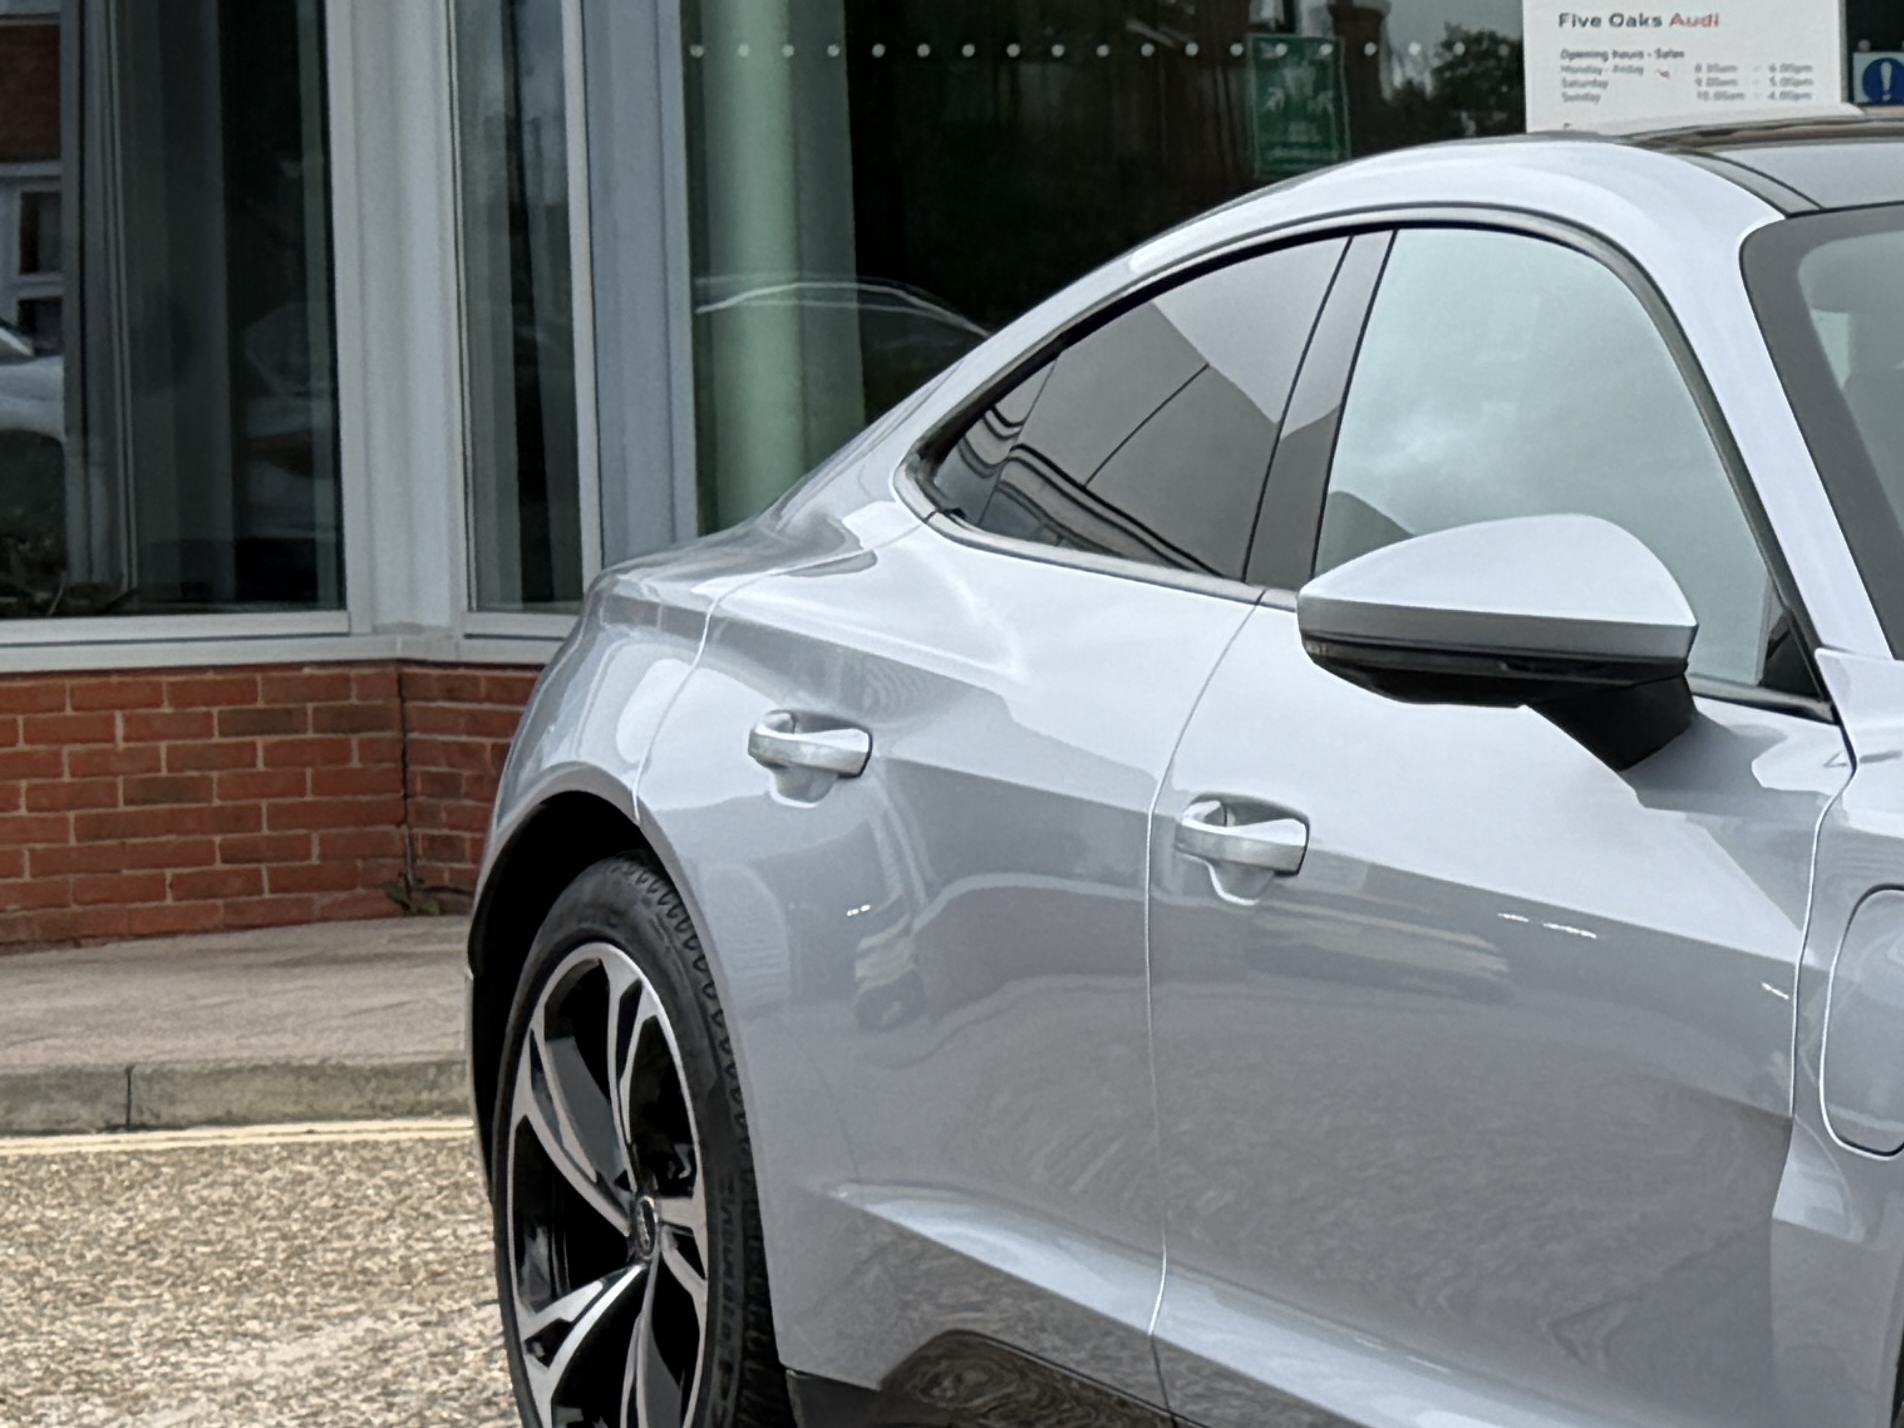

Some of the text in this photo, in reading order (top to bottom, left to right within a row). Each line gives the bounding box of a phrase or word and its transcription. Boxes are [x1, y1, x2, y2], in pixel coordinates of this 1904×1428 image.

[1558, 12, 1720, 28] Five Oaks Audi
